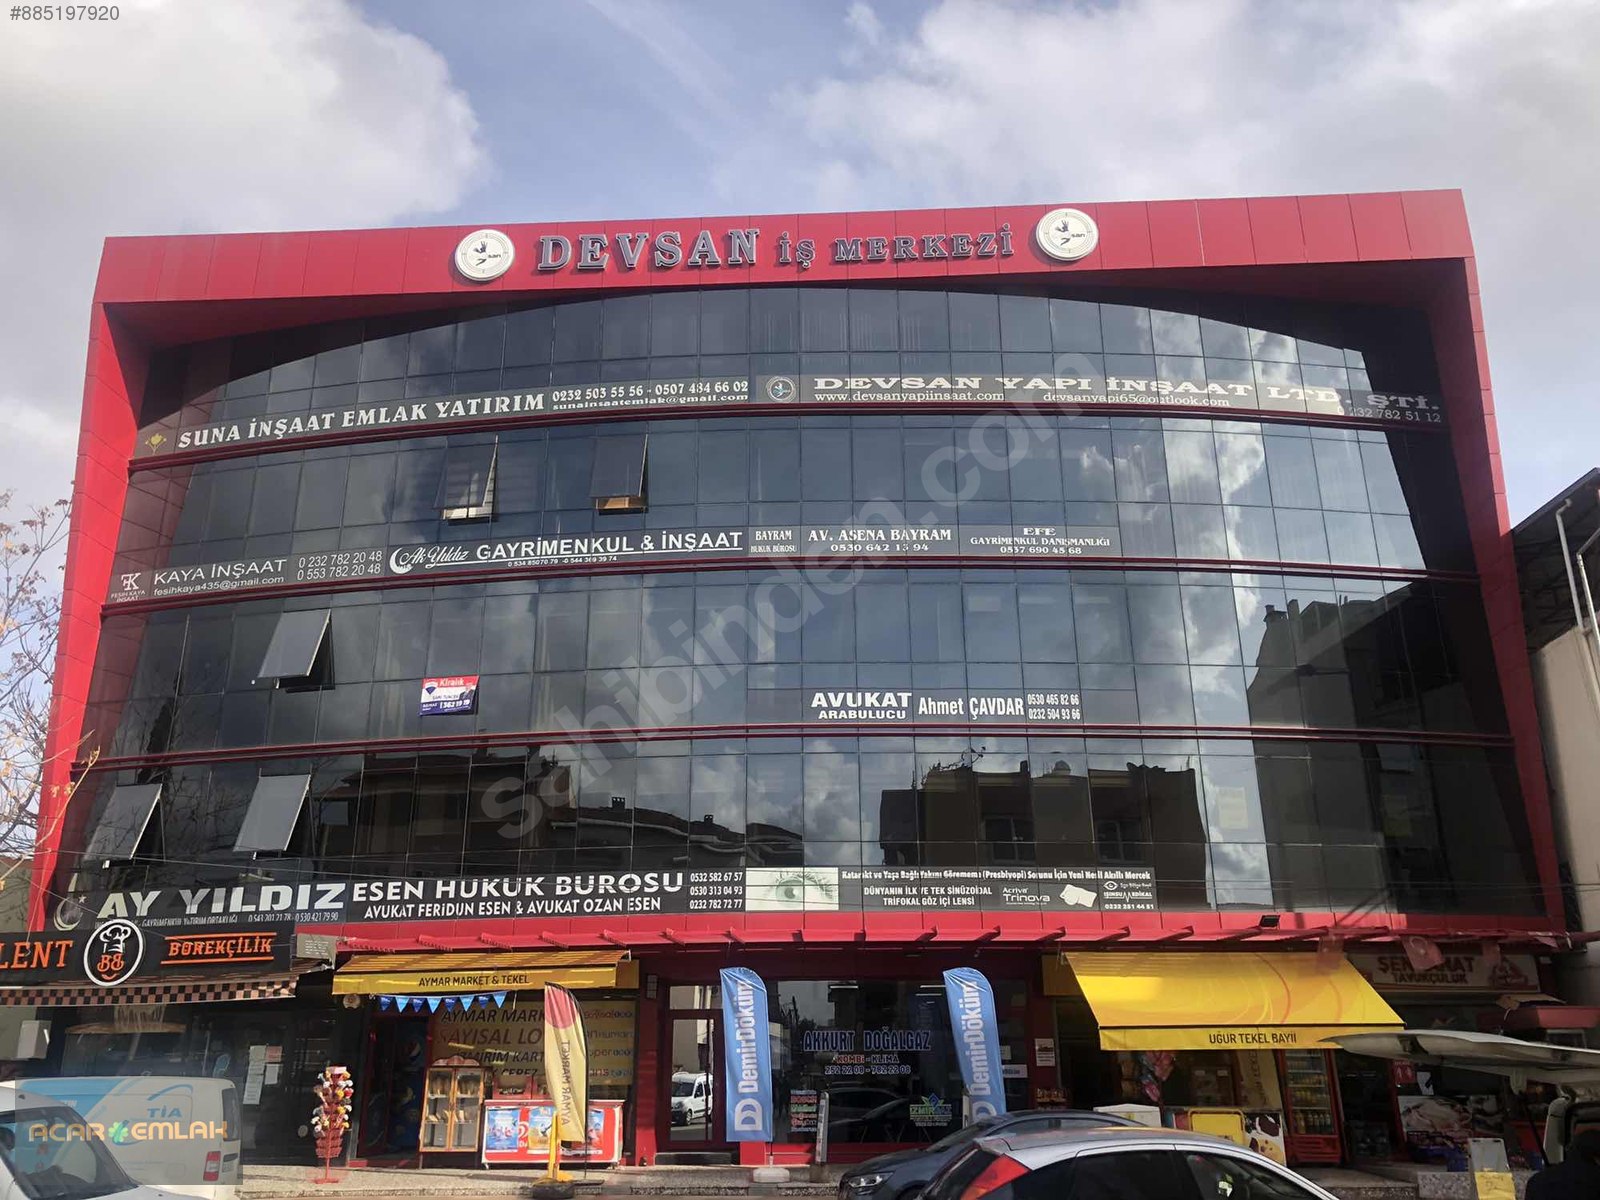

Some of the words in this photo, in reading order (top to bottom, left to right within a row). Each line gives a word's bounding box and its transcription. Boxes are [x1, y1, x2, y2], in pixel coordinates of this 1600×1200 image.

[537, 228, 760, 271] DEVSAN
[778, 231, 816, 268] İŞ
[834, 223, 1015, 261] MERKEZİ
[552, 389, 581, 402] 0232
[585, 387, 607, 399] 503
[610, 386, 625, 397] 55
[629, 385, 644, 397] 56
[655, 383, 685, 395] 0507
[714, 381, 730, 393] 66
[733, 380, 748, 392] 02
[814, 377, 982, 390] DEVSAN
[998, 377, 1092, 390] YAPI
[1105, 376, 1253, 398] İNŞAAT
[814, 391, 1004, 403] www.devsanyapiinsaat.com
[178, 424, 241, 448] SUNA
[247, 412, 335, 440] İNŞAAT
[341, 403, 428, 428] EMLAK
[435, 393, 545, 418] YATIRIM
[1377, 408, 1401, 419] 782
[1406, 410, 1420, 421] 51
[1426, 412, 1441, 423] 12
[755, 529, 792, 541] BAYRAM
[808, 529, 833, 541] AV.
[839, 529, 885, 541] ASENA
[890, 529, 951, 541] BAYRAM
[476, 536, 634, 560] GAYRİMENKUL
[640, 535, 655, 550] &
[661, 531, 743, 551] İNŞAAT
[830, 543, 862, 552] 0530
[866, 543, 890, 552] 642
[913, 543, 929, 552] 94
[1029, 546, 1049, 554] 690
[298, 557, 306, 569] 0
[308, 555, 328, 568] 232
[331, 553, 350, 566] 782
[353, 552, 366, 564] 20
[369, 550, 383, 562] 48
[153, 567, 204, 585] KAYA
[210, 559, 287, 579] İNŞAAT
[297, 569, 304, 581] 0
[306, 568, 326, 580] 553
[330, 566, 349, 578] 782
[352, 564, 365, 576] 20
[367, 563, 381, 575] 48
[153, 575, 284, 597] fesihkaya435@gmail.com
[1027, 693, 1045, 705] 0530
[810, 692, 912, 707] AVUKAT
[918, 697, 964, 716] Ahmet
[969, 697, 1025, 720] ÇAVDAR
[818, 710, 906, 720] ARABULUCU
[1028, 708, 1046, 720] 0232
[690, 873, 707, 882] 0532
[709, 872, 722, 882] 582
[724, 872, 732, 881] 67
[734, 872, 743, 881] 57
[352, 880, 424, 902] ESEN
[436, 877, 545, 898] HUKUK
[690, 886, 707, 896] 0530
[709, 886, 722, 895] 313
[723, 886, 732, 895] 04
[734, 885, 743, 895] 93
[931, 886, 945, 895] TEK
[97, 890, 162, 918] AY
[178, 883, 346, 914] YILDIZ
[689, 900, 707, 909] 0232
[709, 900, 722, 909] 782
[723, 900, 732, 909] 72
[734, 899, 742, 908] 77
[922, 895, 937, 906] GÖZ
[1002, 893, 1050, 902] Trinova
[364, 904, 415, 919] AVUKAT
[478, 901, 511, 915] ESEN
[527, 899, 580, 914] AVUKAT
[583, 898, 622, 913] OZAN
[628, 897, 661, 911] ESEN
[419, 976, 452, 987] AYMAR
[453, 975, 490, 986] MARKET
[492, 975, 499, 984] &
[501, 974, 530, 984] TEKEL
[441, 1009, 496, 1023] AYMAR
[804, 1030, 855, 1051] AKKURT
[864, 1026, 931, 1051] DOĞALGAZ
[1209, 1031, 1237, 1044] UĞUR
[1238, 1033, 1270, 1043] TEKEL
